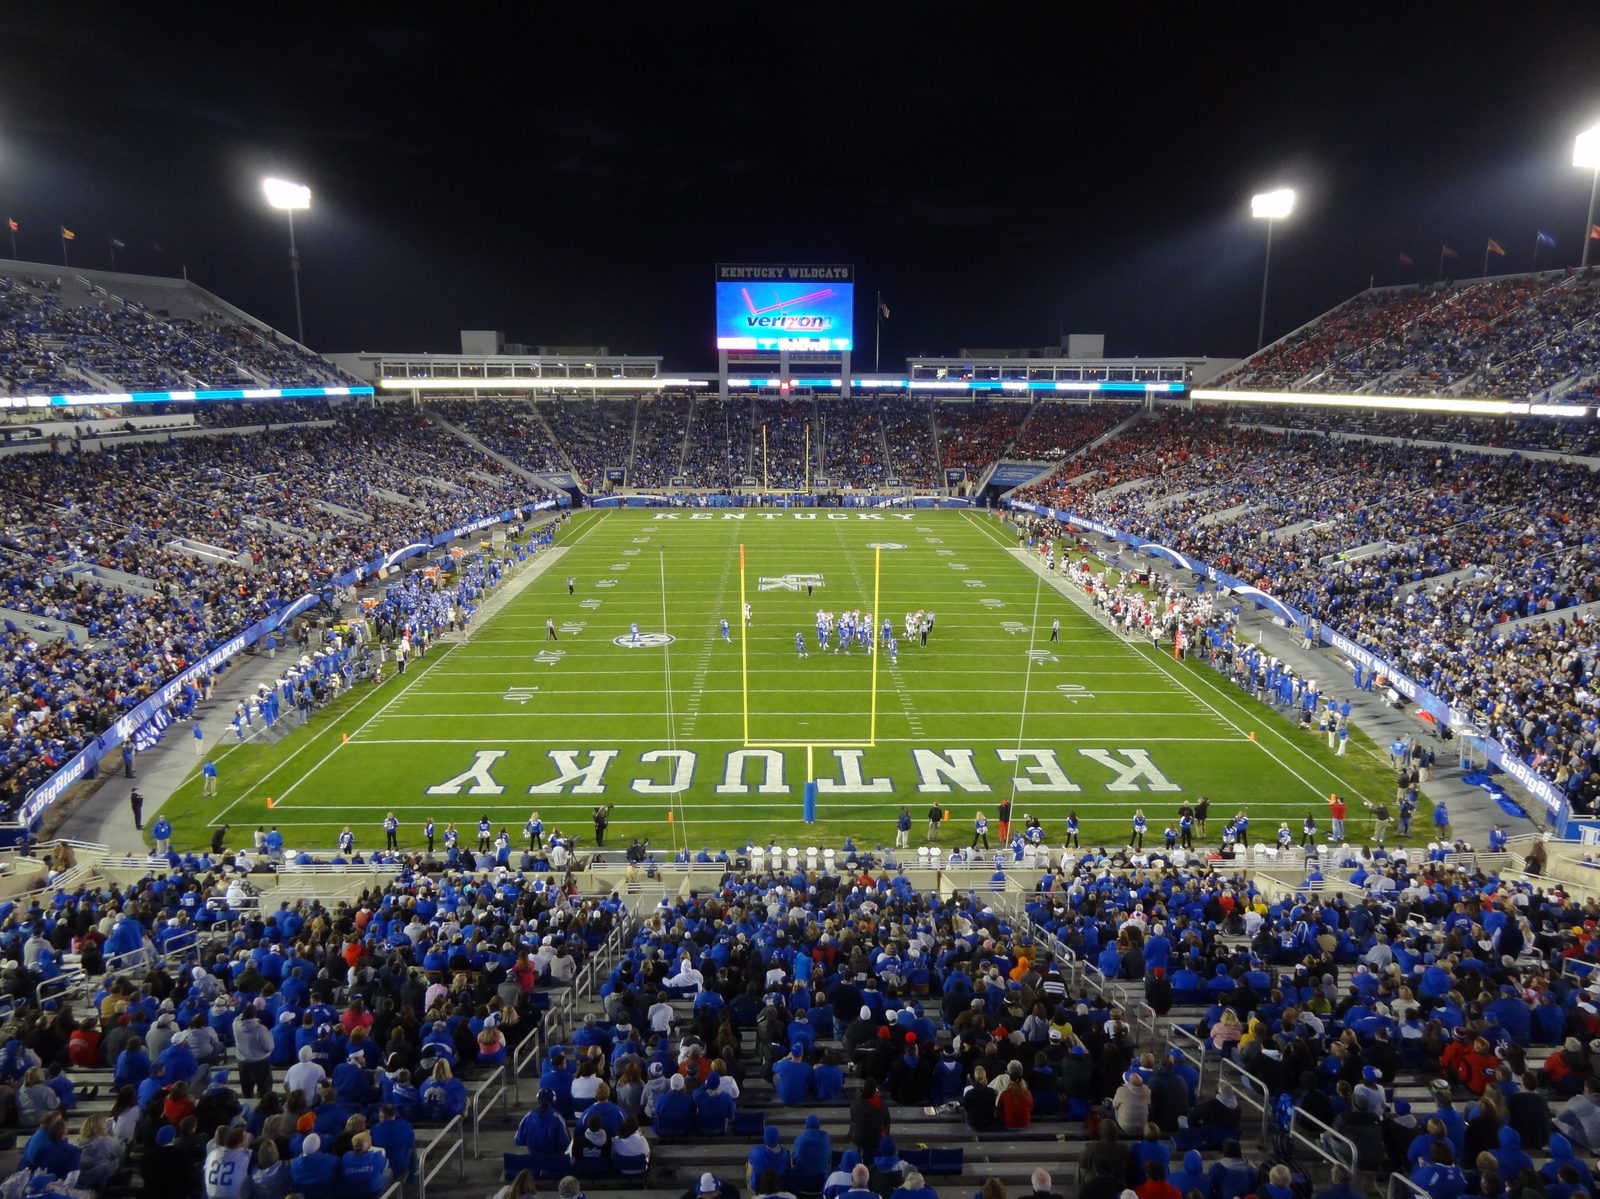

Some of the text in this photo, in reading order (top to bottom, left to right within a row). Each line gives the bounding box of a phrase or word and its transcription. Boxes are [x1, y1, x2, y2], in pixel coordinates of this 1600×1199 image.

[721, 267, 849, 278] KENTUCKY WILDCATS
[1332, 633, 1373, 667] KENTUCKY
[426, 748, 1183, 794] KENTUCKY
[208, 1159, 236, 1187] 22
